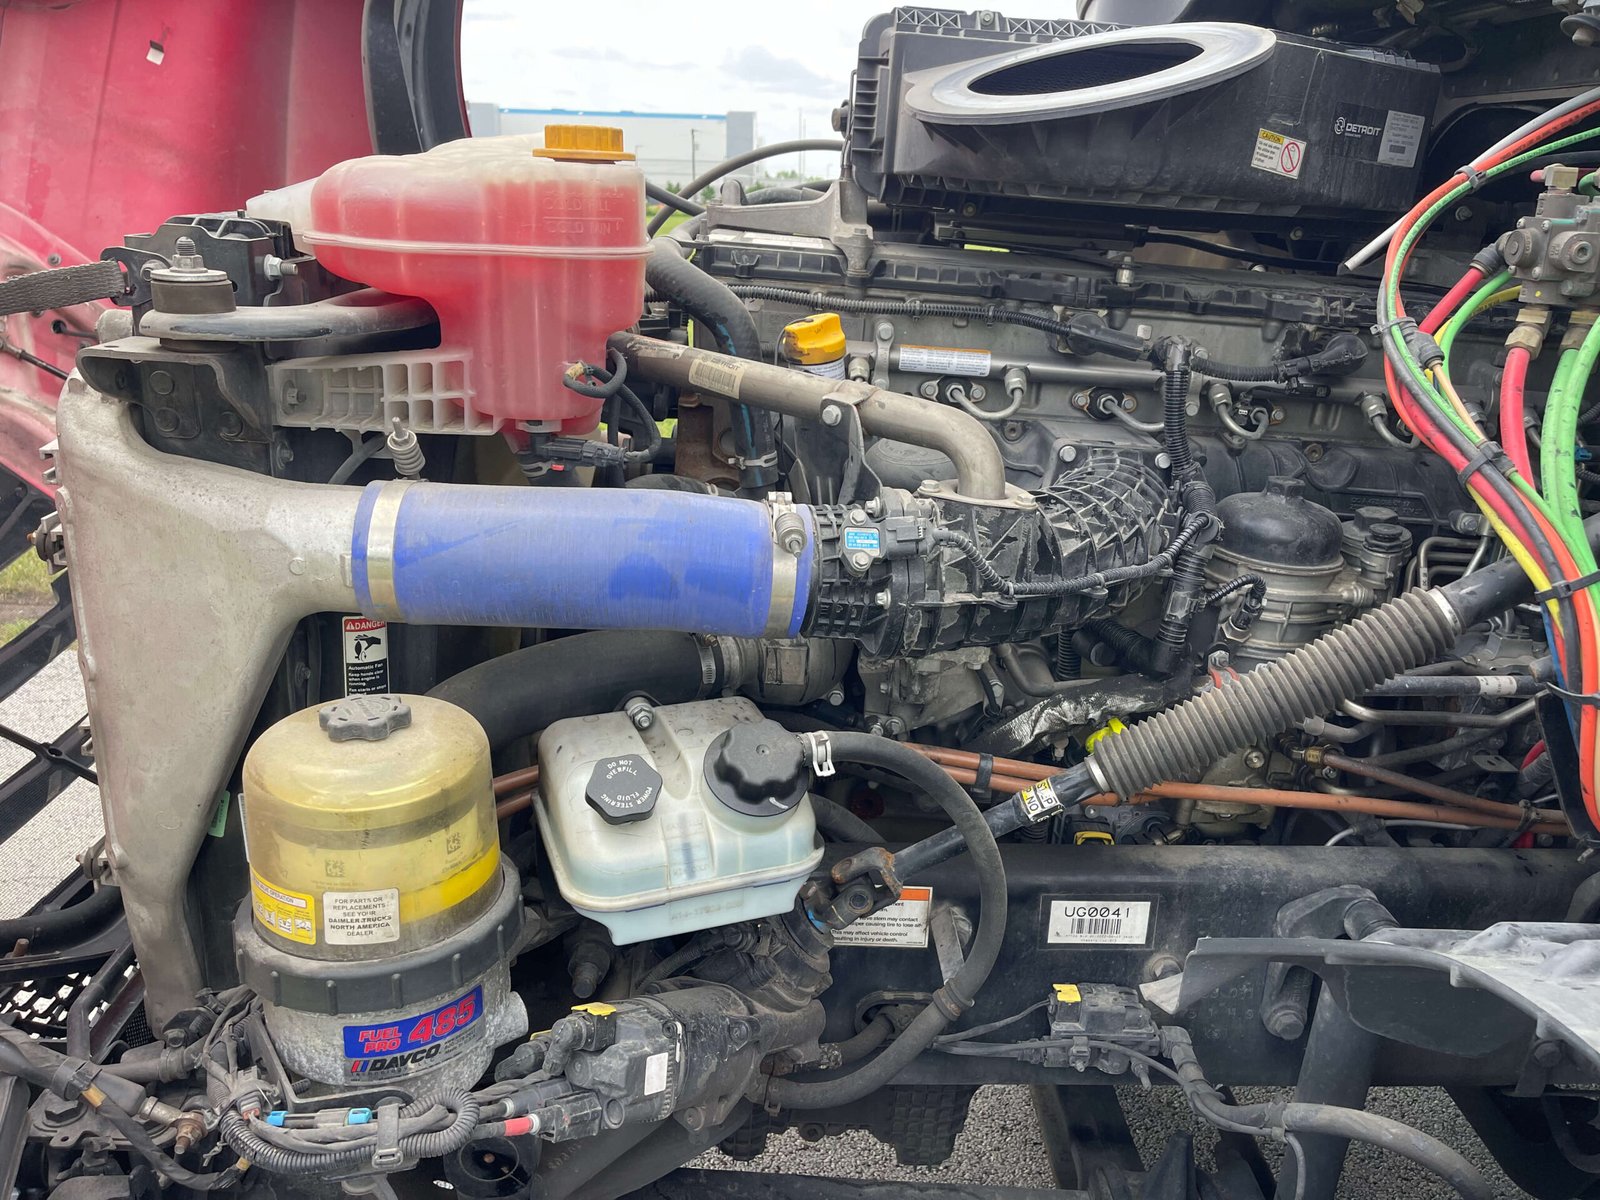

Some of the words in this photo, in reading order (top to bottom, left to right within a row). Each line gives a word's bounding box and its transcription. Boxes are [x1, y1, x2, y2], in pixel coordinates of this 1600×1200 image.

[1345, 122, 1382, 136] DETROIT
[1261, 131, 1281, 143] CAUTION
[607, 761, 617, 769] DO
[606, 766, 638, 780] OVERFILL
[600, 793, 634, 808] STEERING
[616, 791, 640, 801] FLUID
[636, 786, 653, 805] POWER
[332, 903, 386, 911] REPLACEMENTS
[1064, 906, 1130, 918] UG0041
[357, 922, 391, 930] AMERICA
[361, 915, 392, 923] TRUCKS
[408, 993, 477, 1044] 485
[358, 1026, 402, 1043] FUEL
[364, 1039, 401, 1054] PRO
[369, 1044, 441, 1071] DAVCO
